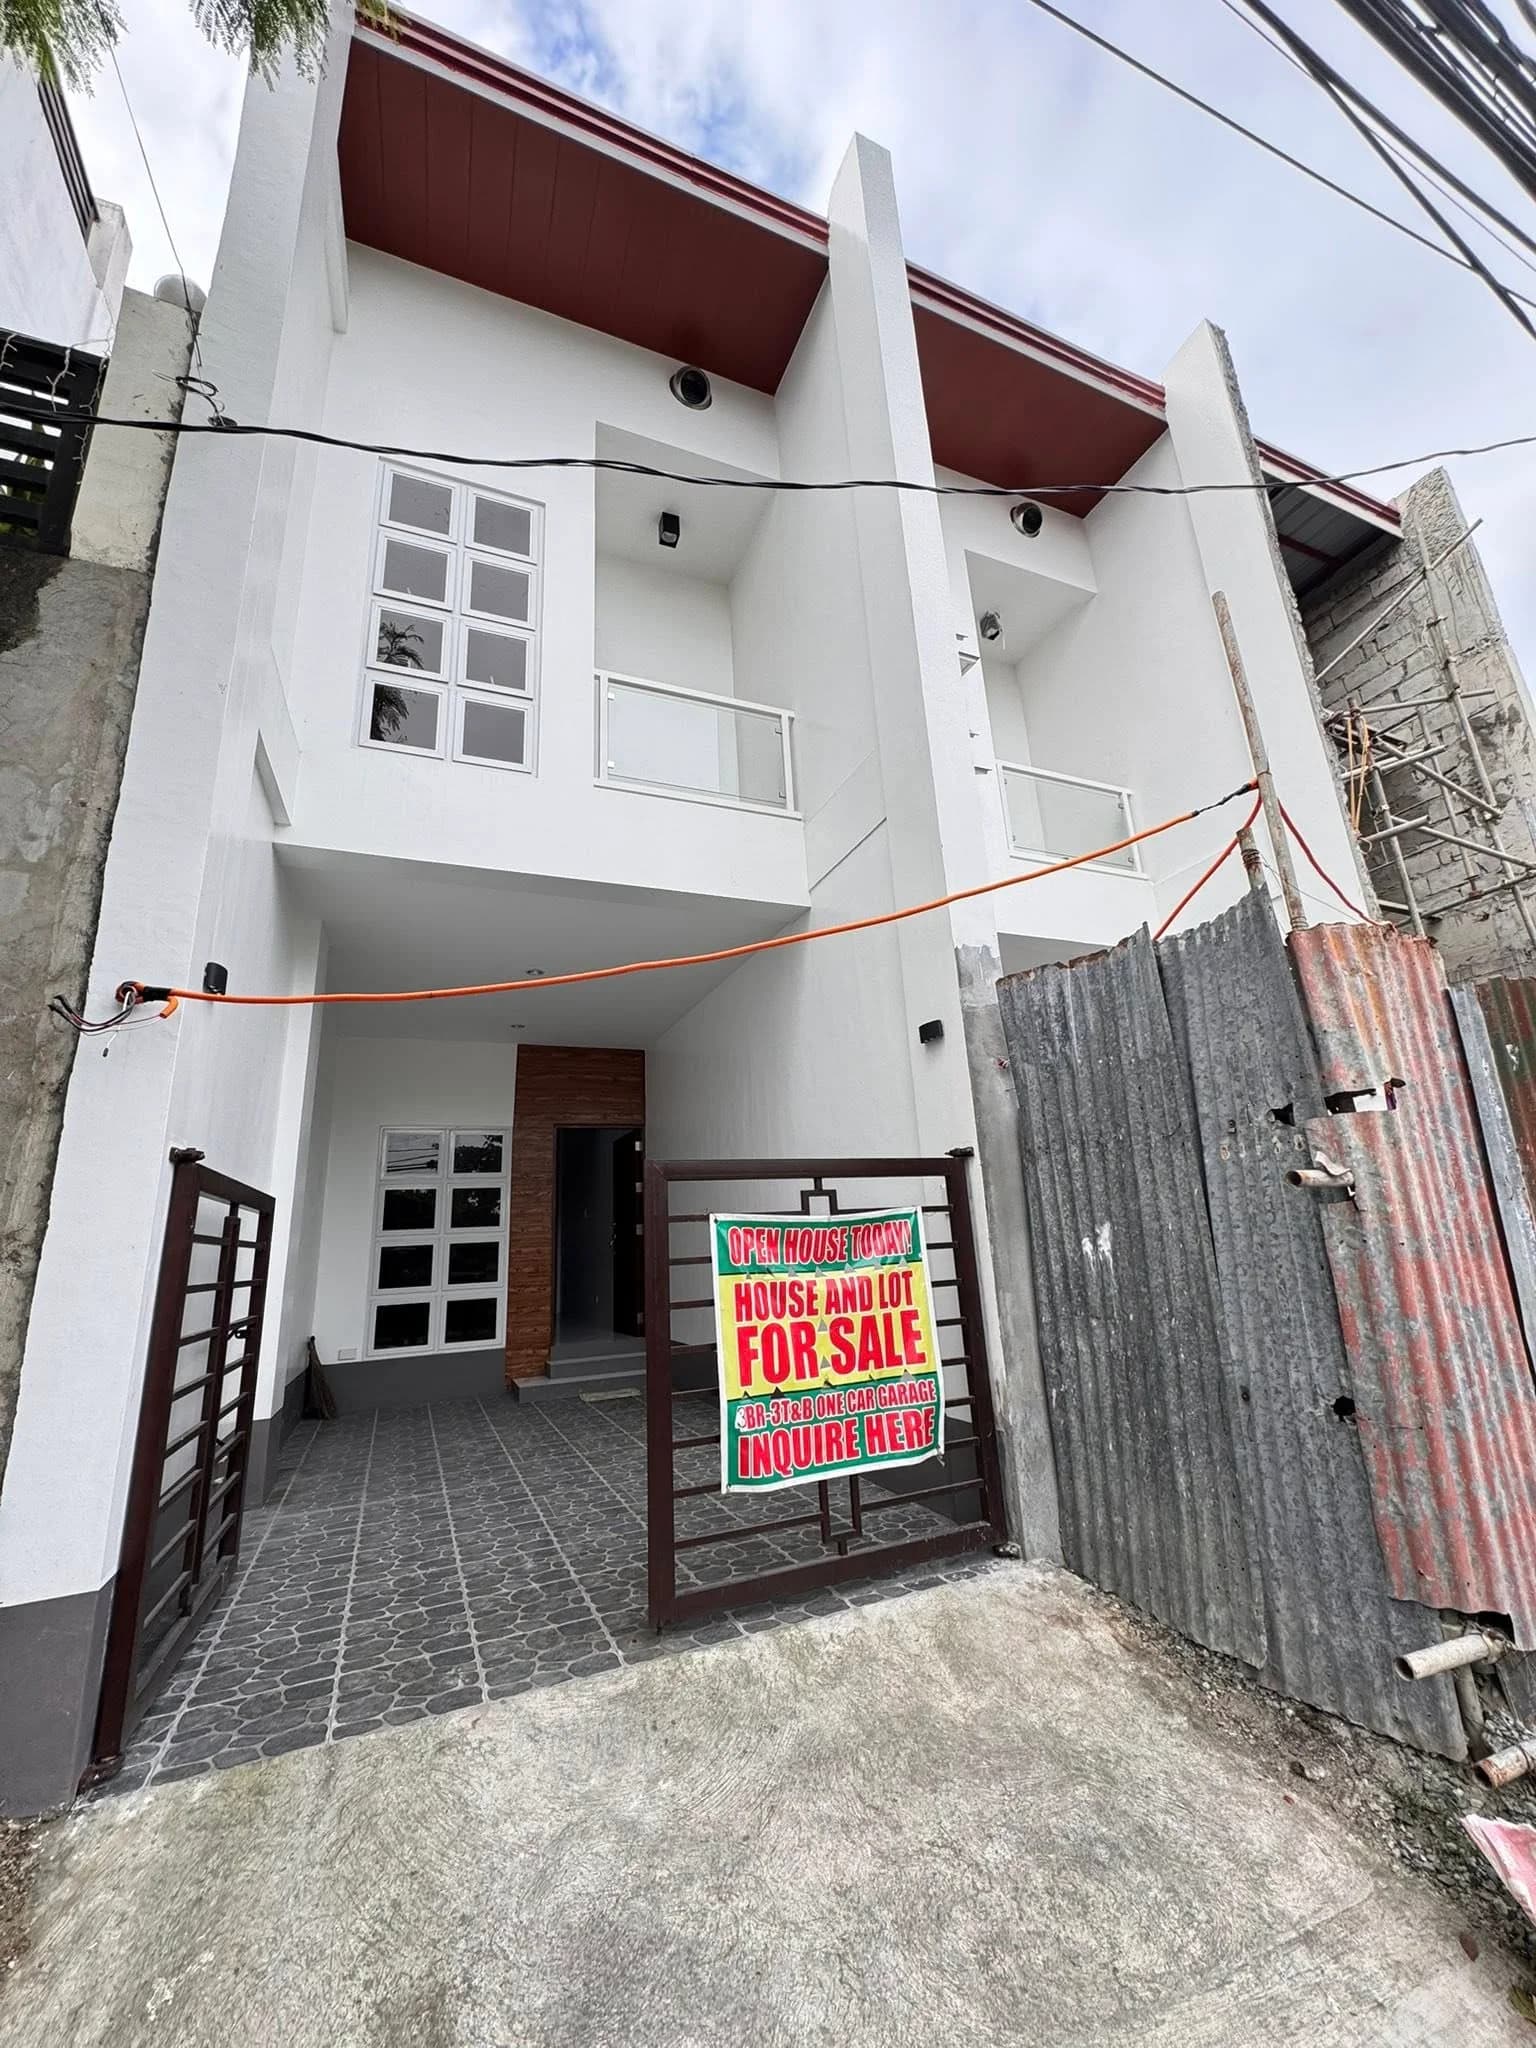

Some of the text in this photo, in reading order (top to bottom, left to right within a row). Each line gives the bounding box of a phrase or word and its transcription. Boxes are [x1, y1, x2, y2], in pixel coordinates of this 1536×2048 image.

[728, 1220, 912, 1266] OPEN HOUSE TODAY!
[735, 1270, 913, 1322] HOUSE AND LOT
[737, 1310, 926, 1386] FOR SALE
[736, 1381, 936, 1430] 3BR-3T&B ONE CAR GARAGE
[738, 1408, 934, 1478] INQUIRE HERE
